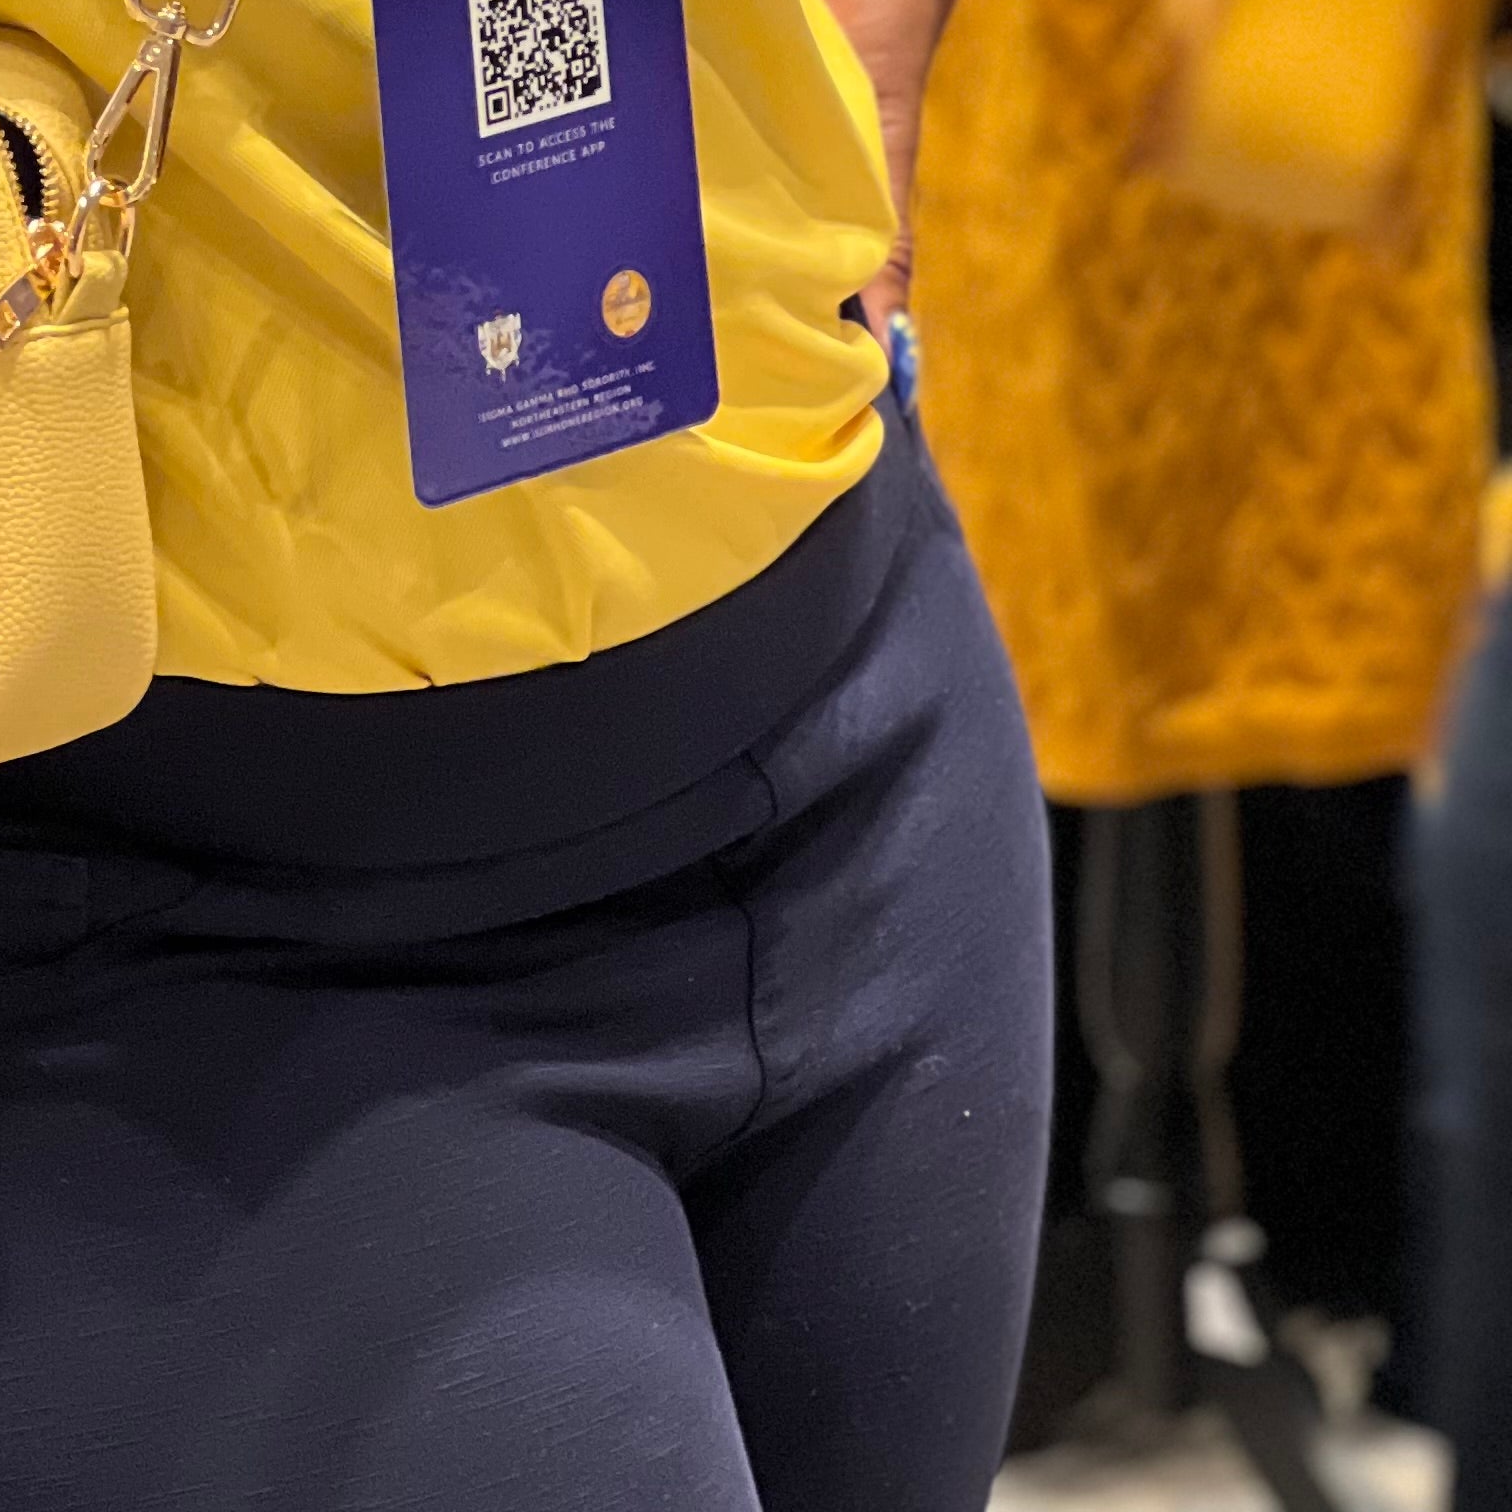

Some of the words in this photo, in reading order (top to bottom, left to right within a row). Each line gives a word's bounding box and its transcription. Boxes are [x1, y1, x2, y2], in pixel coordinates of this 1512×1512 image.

[478, 147, 513, 168] SCAN
[517, 141, 535, 156] TO
[539, 125, 587, 150] ACCESS
[590, 117, 616, 135] THE
[491, 149, 577, 185] CONFERENCE
[582, 141, 606, 158] APP
